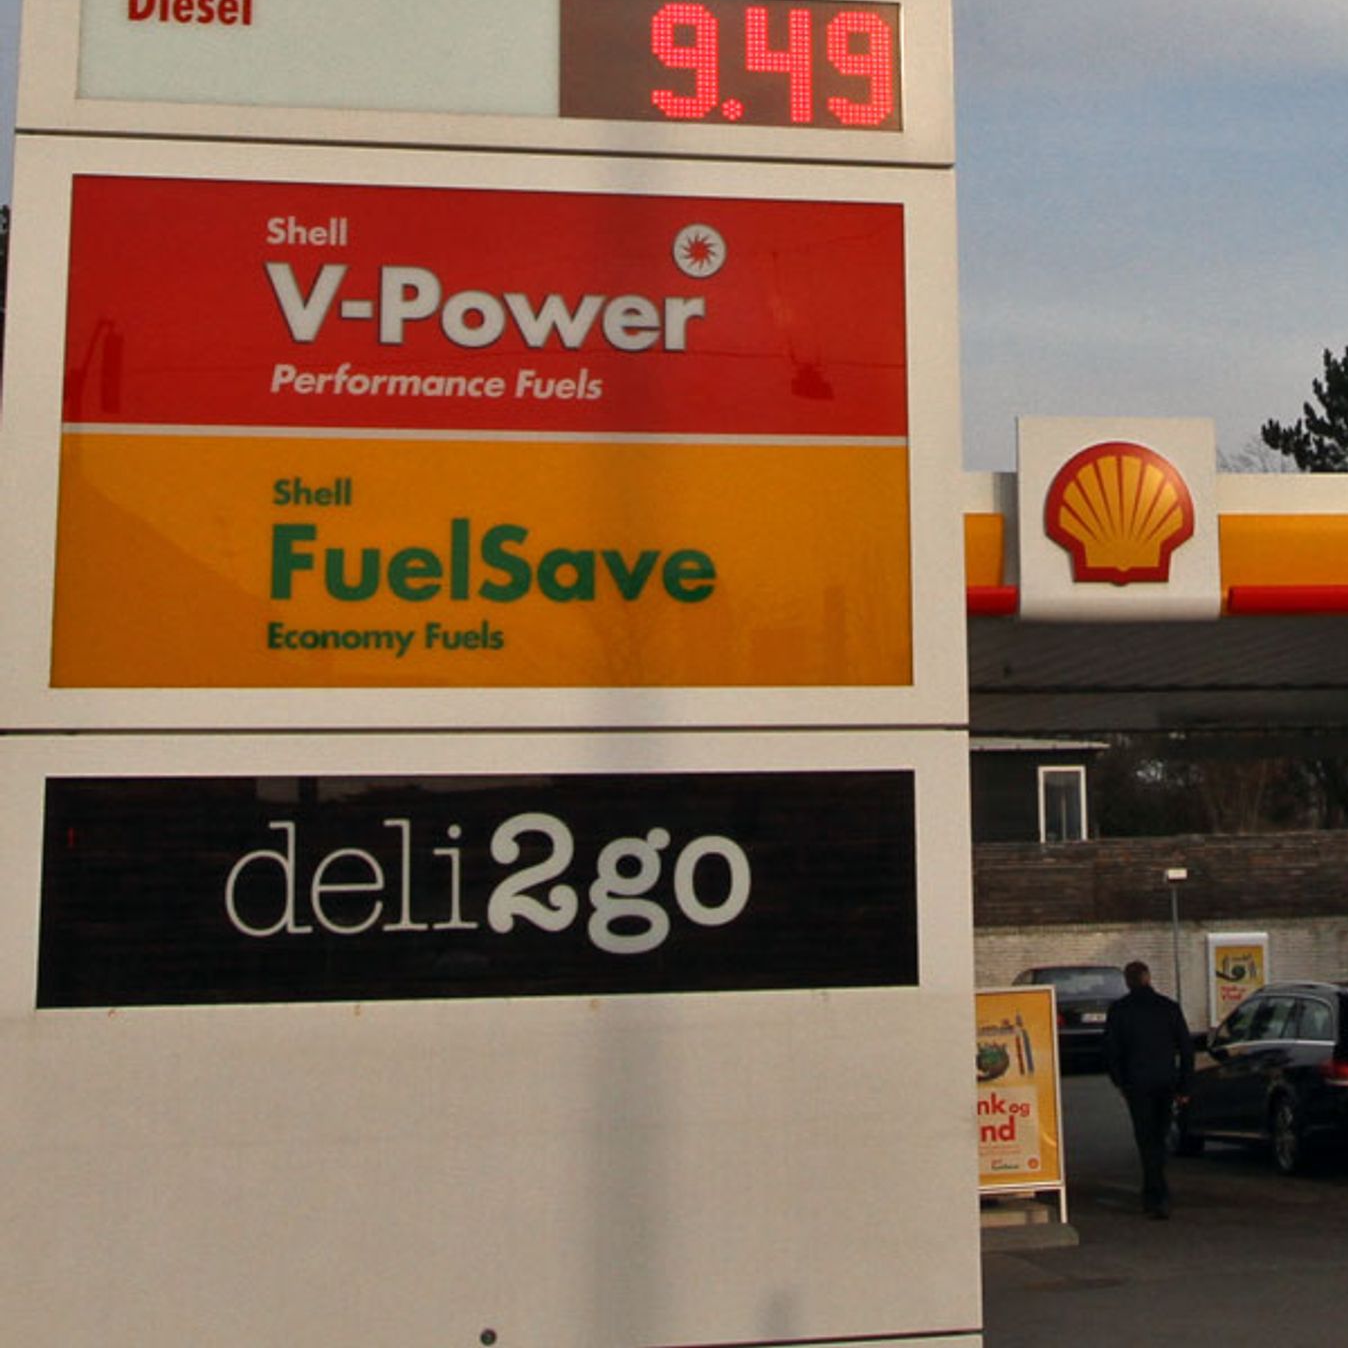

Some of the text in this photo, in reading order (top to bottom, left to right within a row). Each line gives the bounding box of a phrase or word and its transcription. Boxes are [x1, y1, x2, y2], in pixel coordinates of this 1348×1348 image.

[651, 2, 895, 126] 9.49
[266, 217, 348, 247] Shell
[264, 261, 707, 351] V-Power
[271, 363, 603, 401] Performance Fuels
[272, 477, 352, 507] Shell
[269, 517, 717, 604] FuelSave
[267, 620, 505, 658] Economy Fuels
[224, 812, 752, 954] deli2go
[977, 1092, 1030, 1116] nk og
[980, 1115, 1015, 1142] nd
